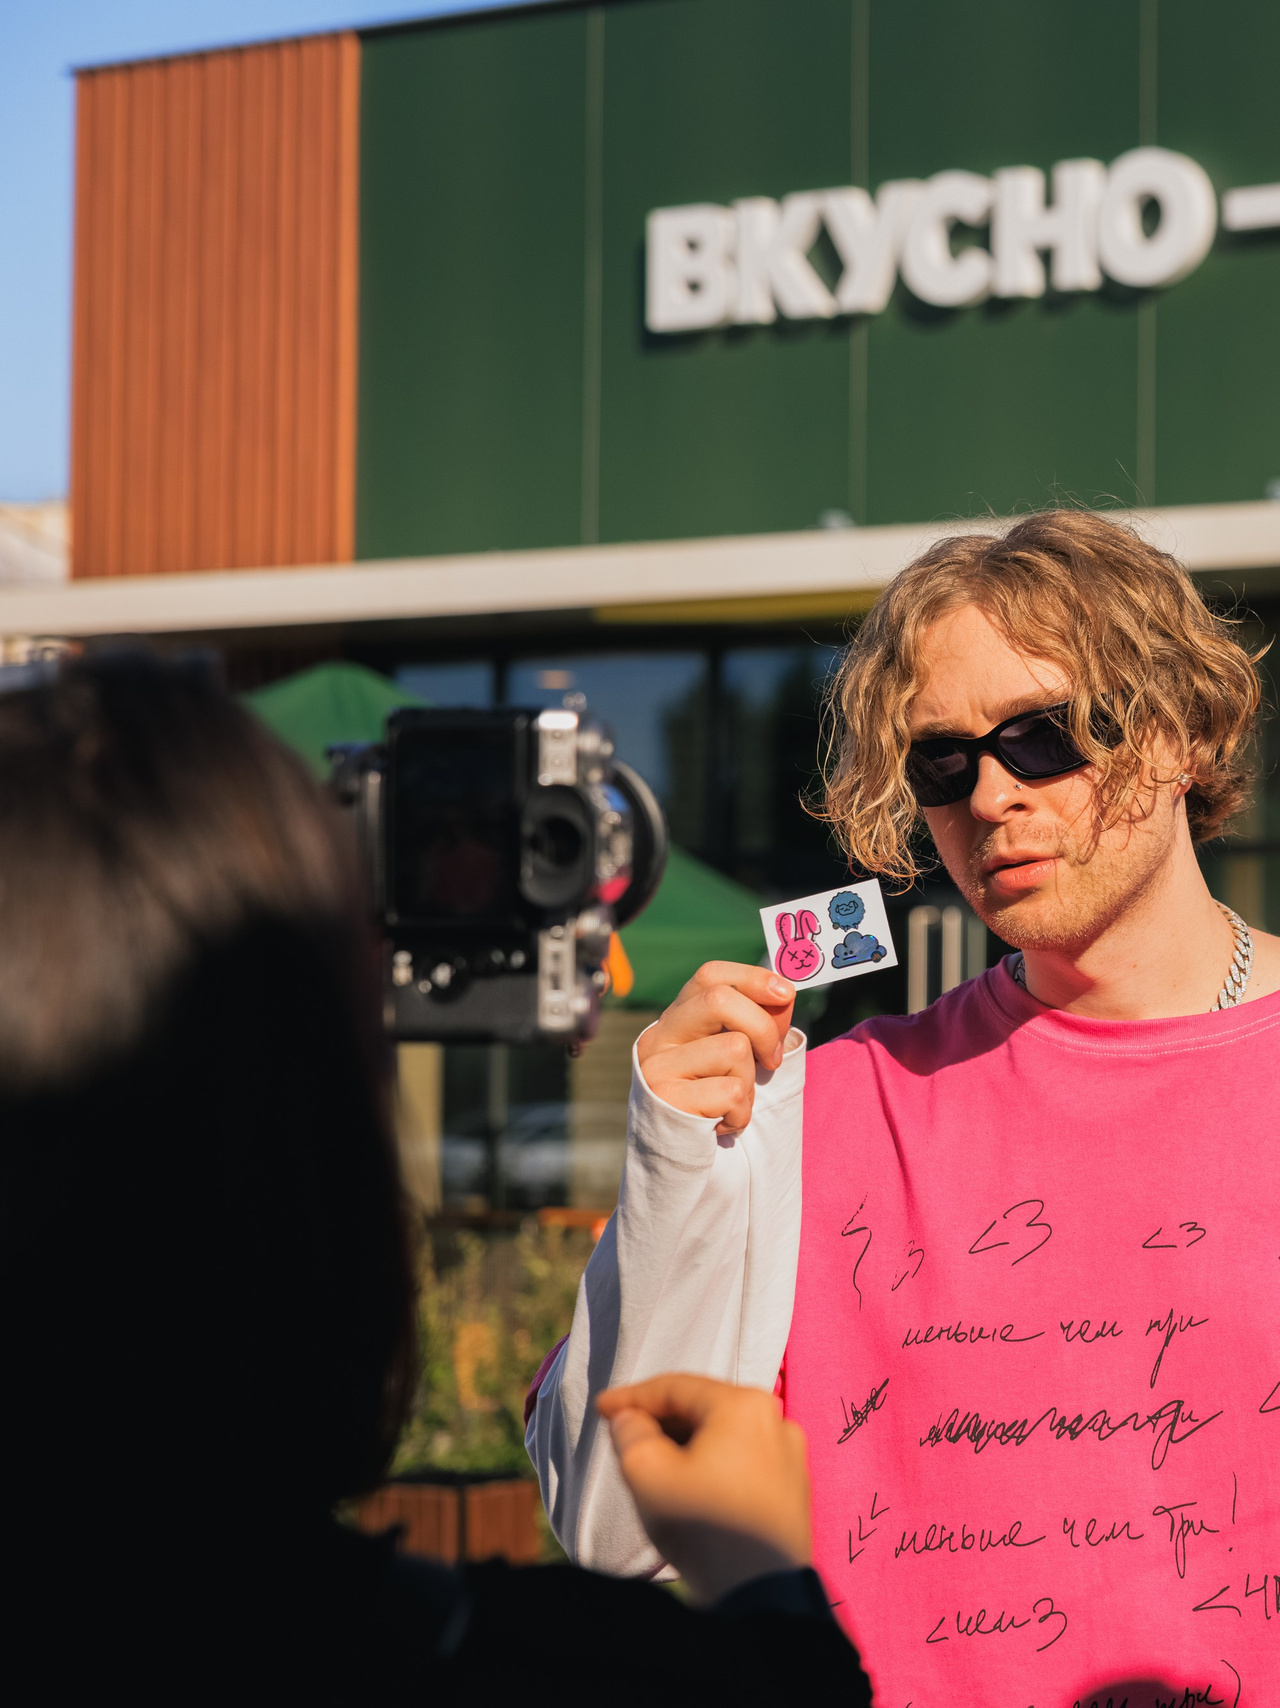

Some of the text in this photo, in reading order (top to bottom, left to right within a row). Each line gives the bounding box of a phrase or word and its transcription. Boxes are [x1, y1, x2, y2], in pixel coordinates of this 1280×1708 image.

[901, 1319, 1046, 1349] меньше
[1059, 1319, 1124, 1344] чем
[894, 1519, 1047, 1559] меньше
[1062, 1516, 1146, 1548] чем
